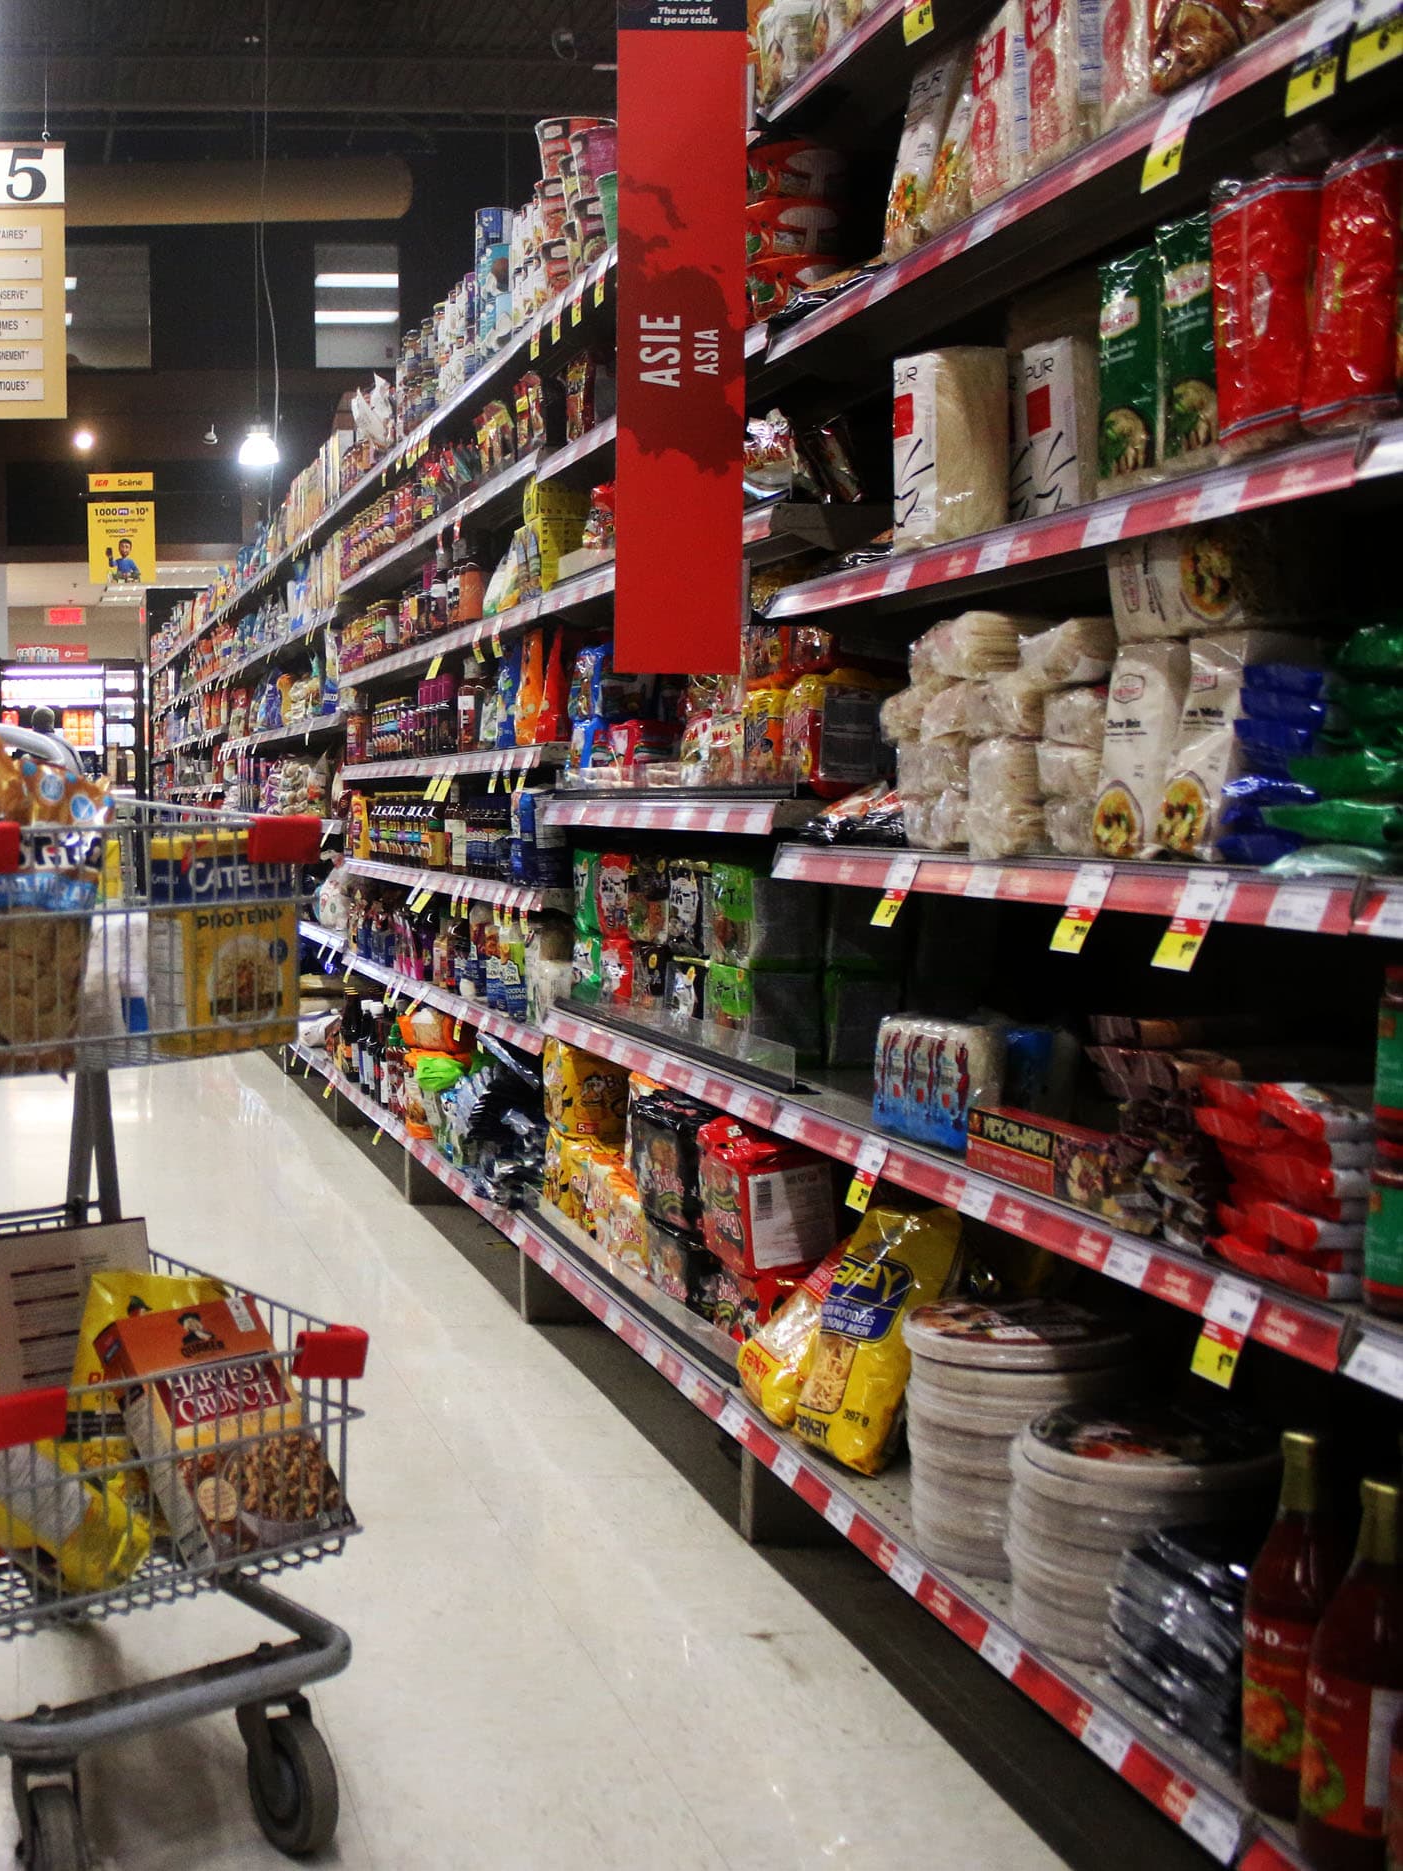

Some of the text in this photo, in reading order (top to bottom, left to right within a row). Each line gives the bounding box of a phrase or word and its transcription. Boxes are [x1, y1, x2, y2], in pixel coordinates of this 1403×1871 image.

[649, 16, 718, 26] at your table
[658, 7, 710, 15] The world
[6, 147, 46, 202] 5
[640, 314, 680, 387] ASIE
[694, 329, 719, 375] ASIA
[95, 508, 117, 516] 1000
[177, 1379, 280, 1424] CRUNCH
[842, 1409, 861, 1423] 397
